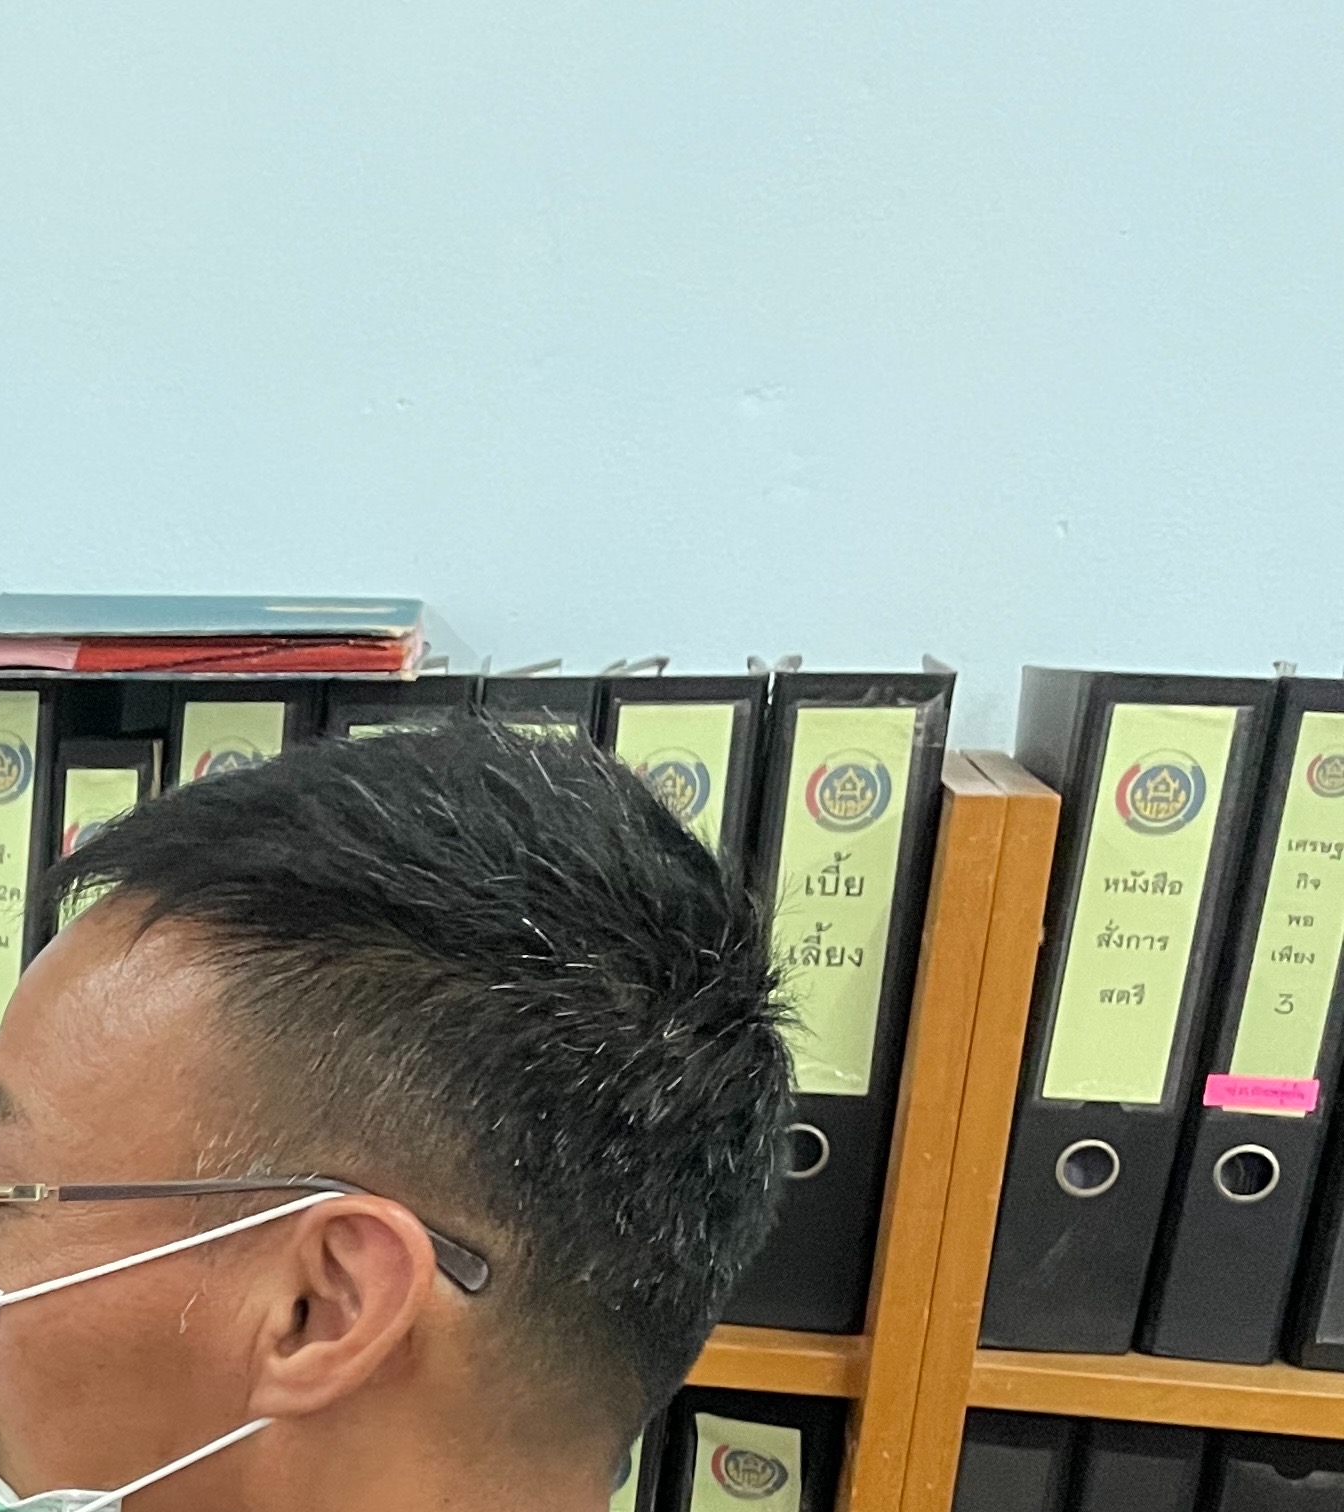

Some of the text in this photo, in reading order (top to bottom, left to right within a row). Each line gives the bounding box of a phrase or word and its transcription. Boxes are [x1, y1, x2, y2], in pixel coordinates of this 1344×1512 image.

[805, 851, 864, 896] เบี้ย
[1104, 869, 1183, 896] หนังสือ
[1296, 872, 1321, 889] กิจ
[1288, 914, 1314, 927] พอ
[789, 921, 863, 967] เลี้ยง
[1096, 918, 1169, 951] สั่งการ
[1271, 945, 1315, 964] เพียง
[1099, 983, 1145, 1005] สตรี
[1274, 993, 1294, 1015] 3
